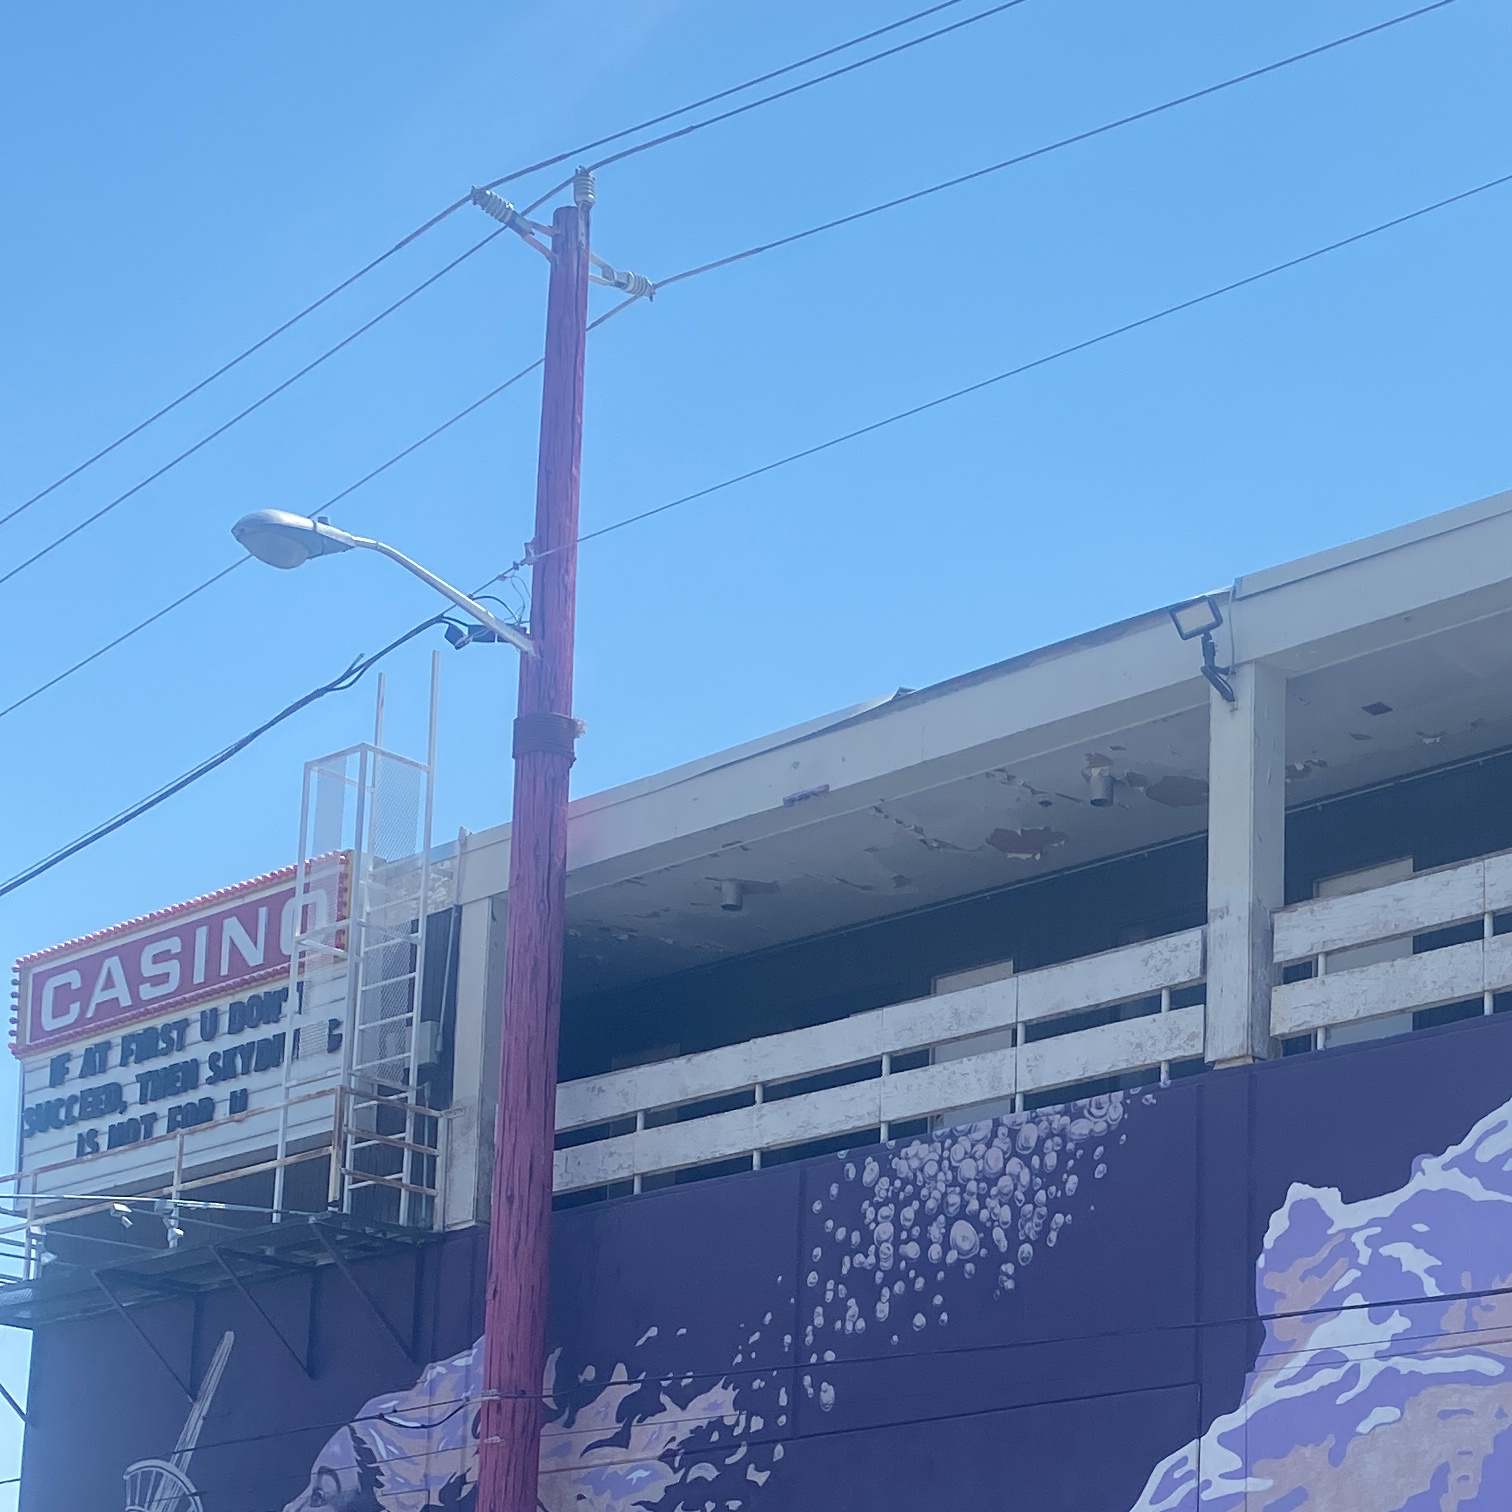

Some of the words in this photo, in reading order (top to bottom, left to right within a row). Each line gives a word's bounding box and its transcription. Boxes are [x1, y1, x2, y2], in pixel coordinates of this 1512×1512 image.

[41, 888, 328, 1031] CASINO
[79, 1040, 113, 1078] AT
[119, 1018, 190, 1067] FIRST
[199, 1007, 218, 1042] U
[135, 1058, 199, 1105] THEN
[76, 1128, 100, 1158] IS
[107, 1112, 158, 1150] NOT
[166, 1097, 216, 1133] FOR
